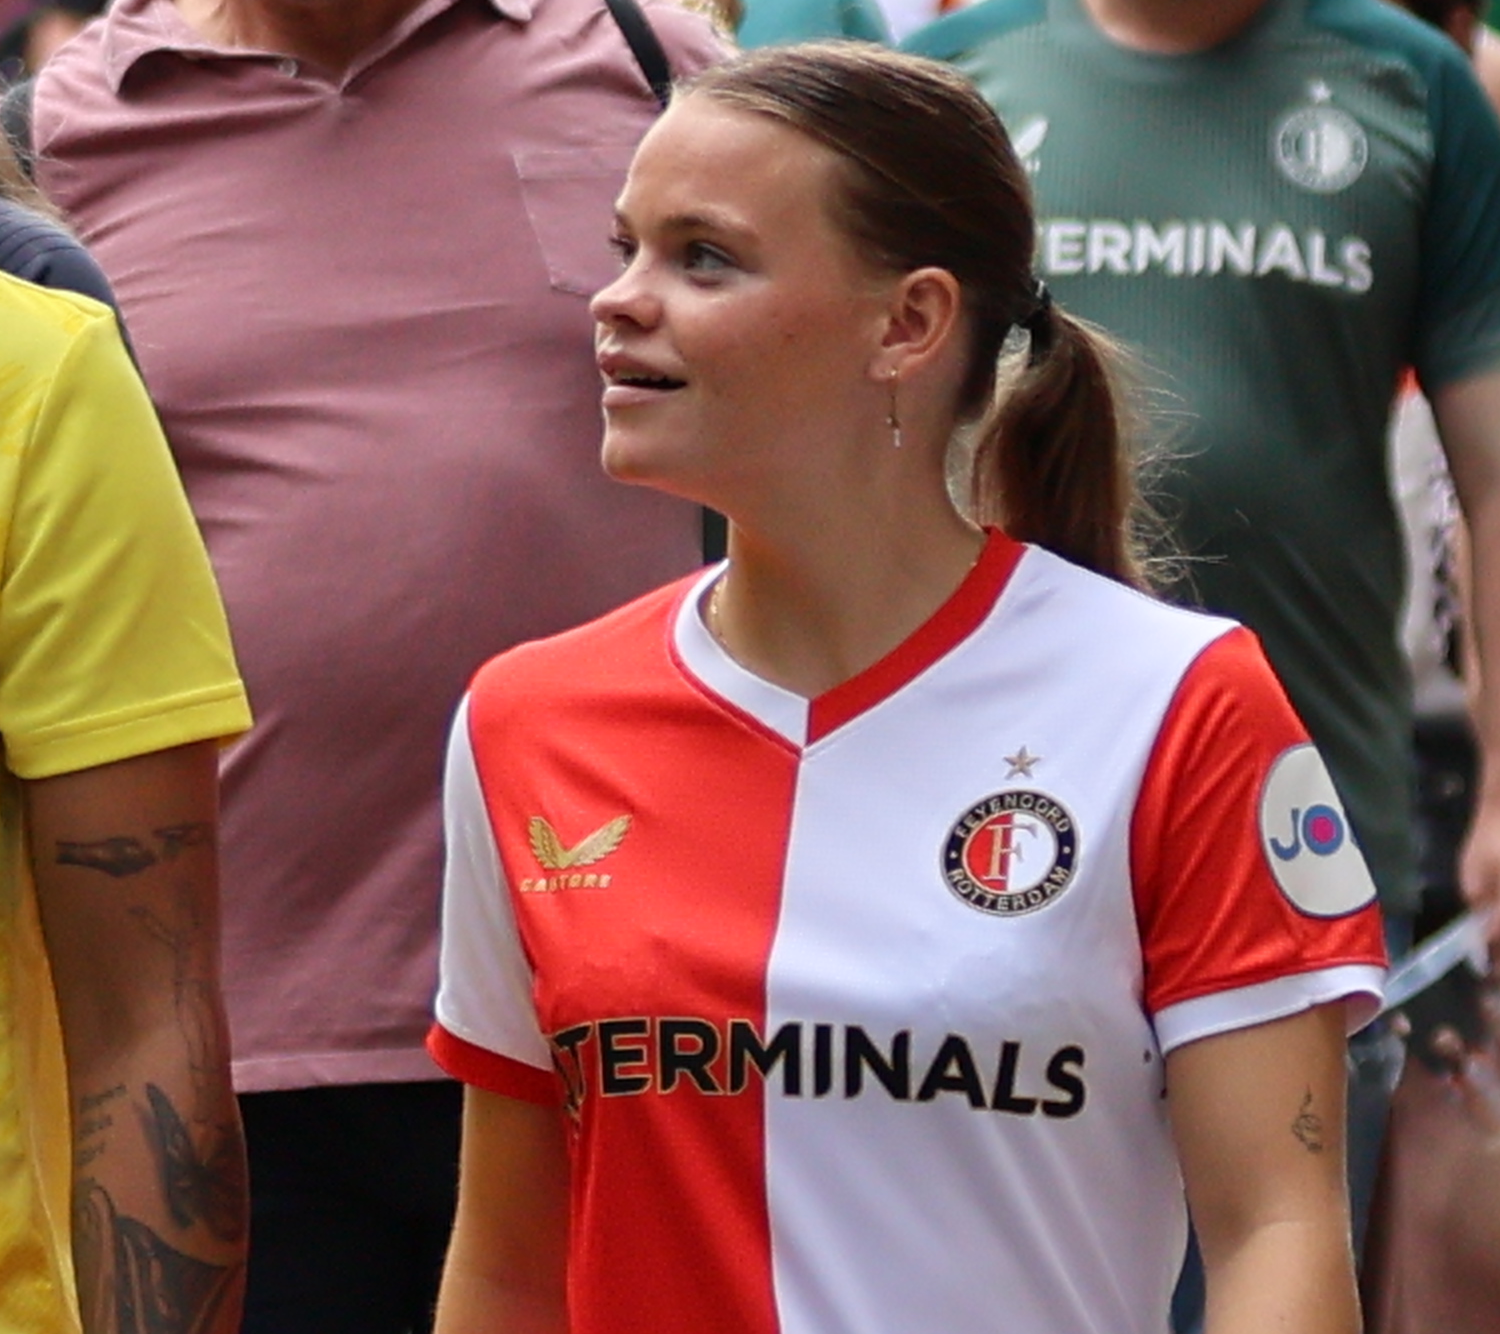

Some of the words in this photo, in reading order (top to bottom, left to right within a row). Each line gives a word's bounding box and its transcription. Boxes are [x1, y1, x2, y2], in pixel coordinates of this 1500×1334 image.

[1033, 217, 1375, 294] ERMINALS
[954, 794, 1070, 839] FEYENOORD
[947, 866, 1070, 911] ROTTERDAM
[550, 1017, 1088, 1120] TERMINALS
